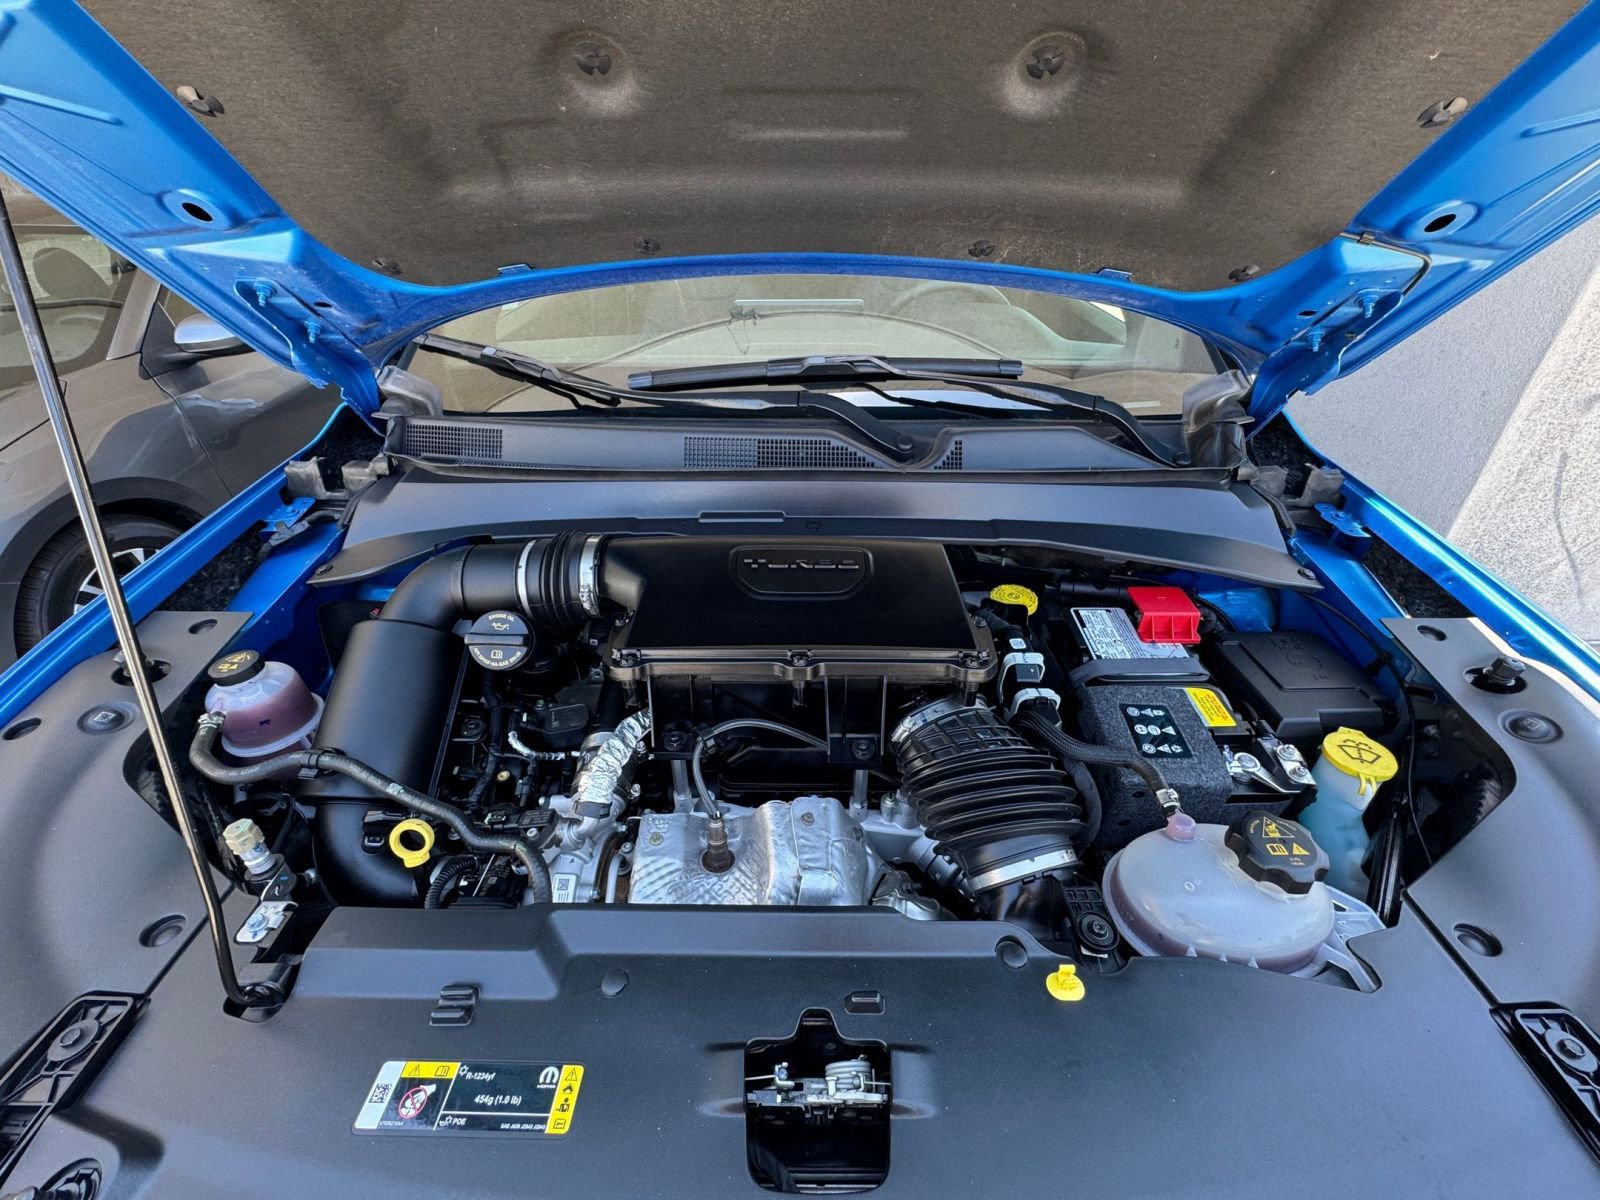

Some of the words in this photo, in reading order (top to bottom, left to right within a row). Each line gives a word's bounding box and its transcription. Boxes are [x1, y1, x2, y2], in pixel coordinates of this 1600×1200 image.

[465, 1072, 496, 1082] R-1234yf
[474, 1094, 494, 1106] 454g
[494, 1094, 510, 1106] (1.0
[510, 1095, 522, 1106] lb)
[452, 1117, 467, 1125] POE
